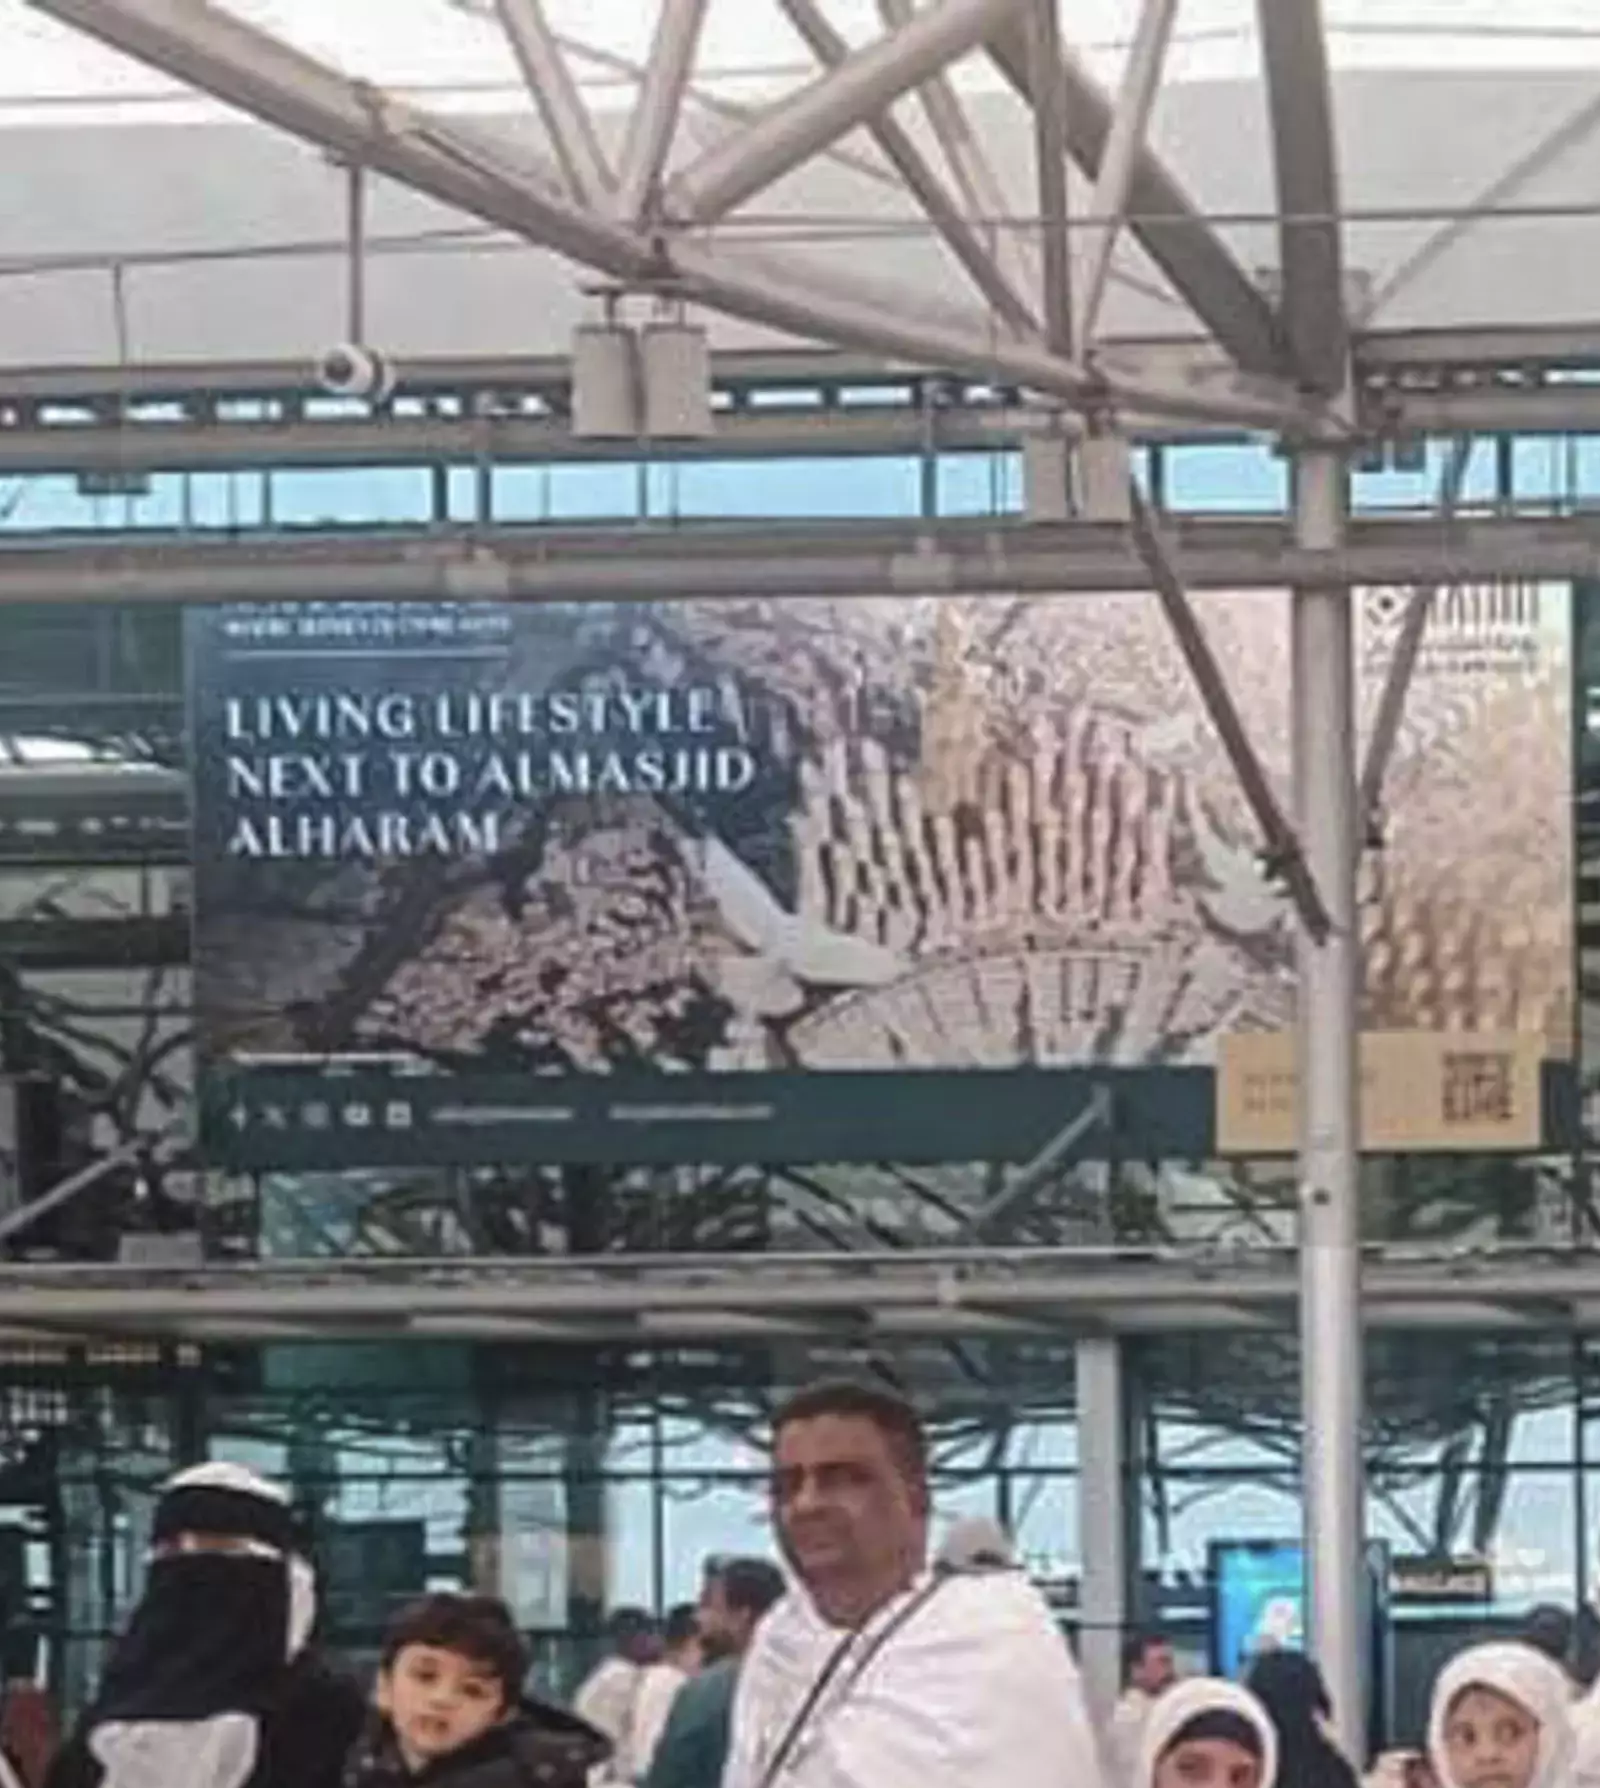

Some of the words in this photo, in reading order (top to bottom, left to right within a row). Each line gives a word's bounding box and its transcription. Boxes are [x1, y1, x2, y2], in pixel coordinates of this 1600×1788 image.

[226, 692, 414, 740] LIVING
[437, 688, 716, 736] LIFESTYLE
[226, 753, 367, 799] NEXT
[388, 752, 460, 797] TO
[476, 748, 755, 798] ALMASJID
[228, 811, 499, 857] ALHARAM
